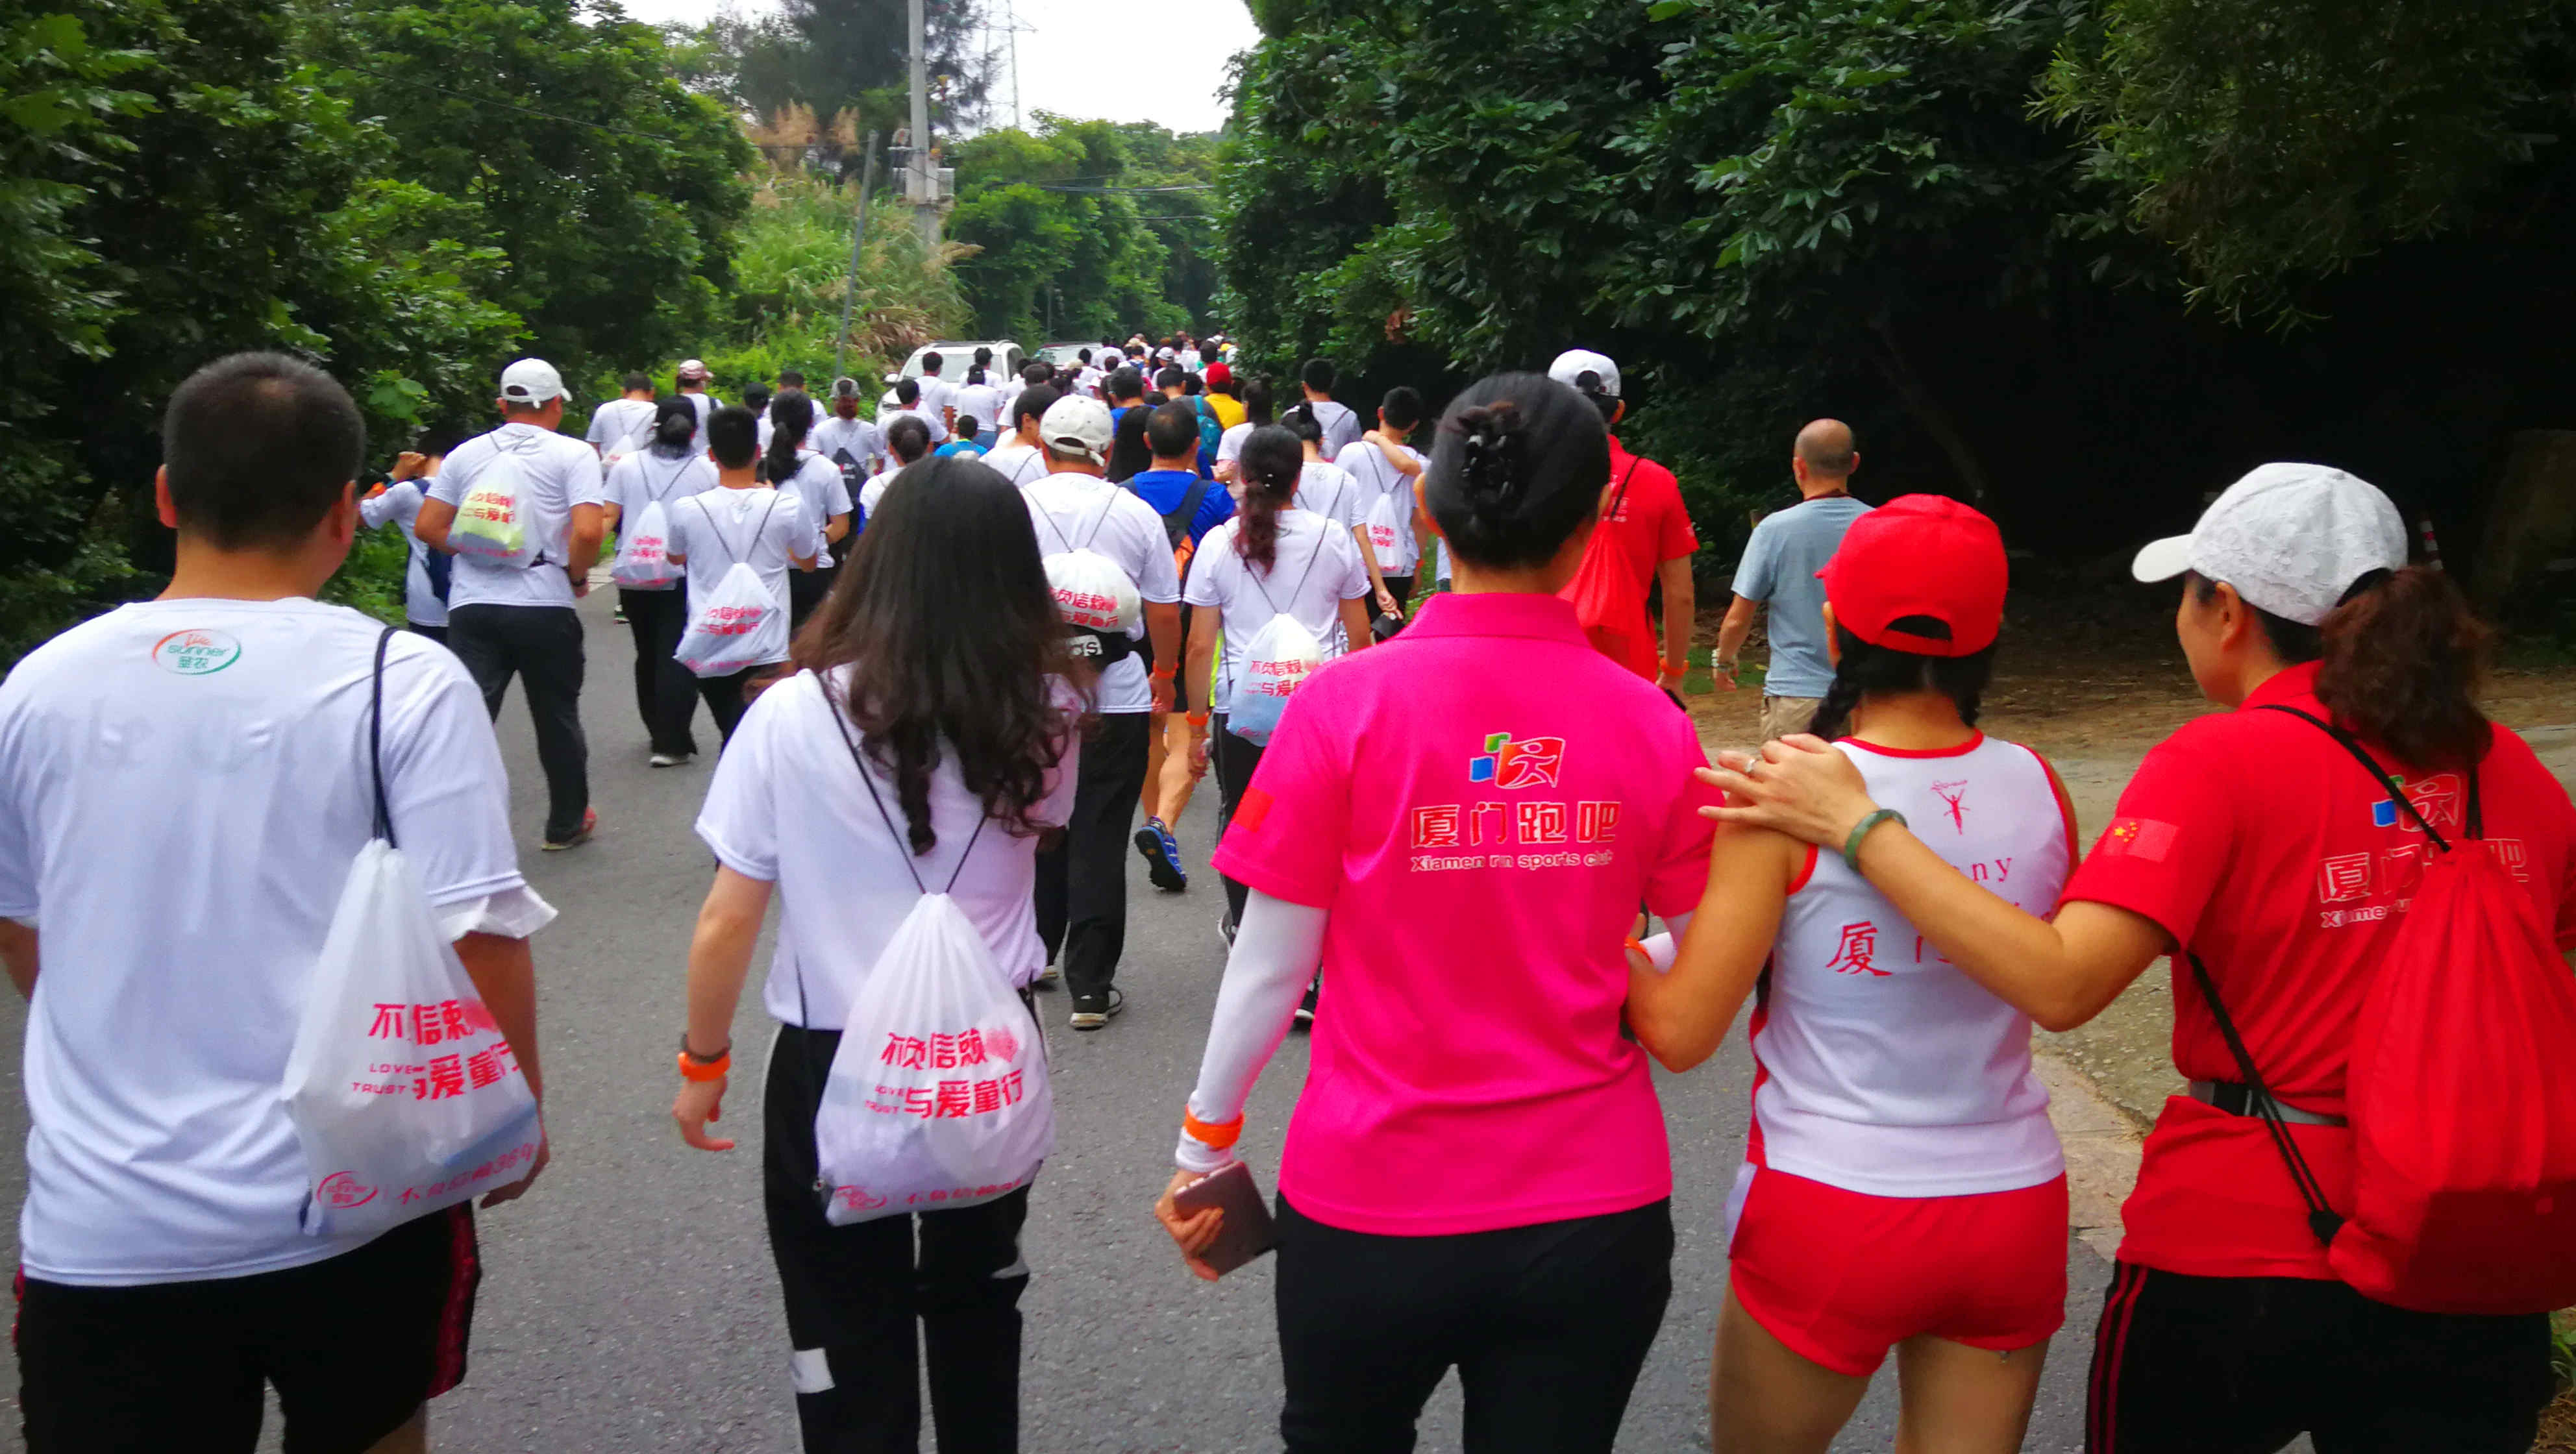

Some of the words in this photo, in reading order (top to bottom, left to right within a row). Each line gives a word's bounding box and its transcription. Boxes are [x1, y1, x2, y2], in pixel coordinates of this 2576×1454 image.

[1411, 801, 1621, 848] 厦门跑吧
[1411, 854, 1485, 872] Xiamen
[1518, 851, 1581, 870] sports
[369, 1062, 413, 1075] LOVE
[351, 1082, 408, 1095] TRUST
[903, 1067, 1023, 1119] 与爱童行
